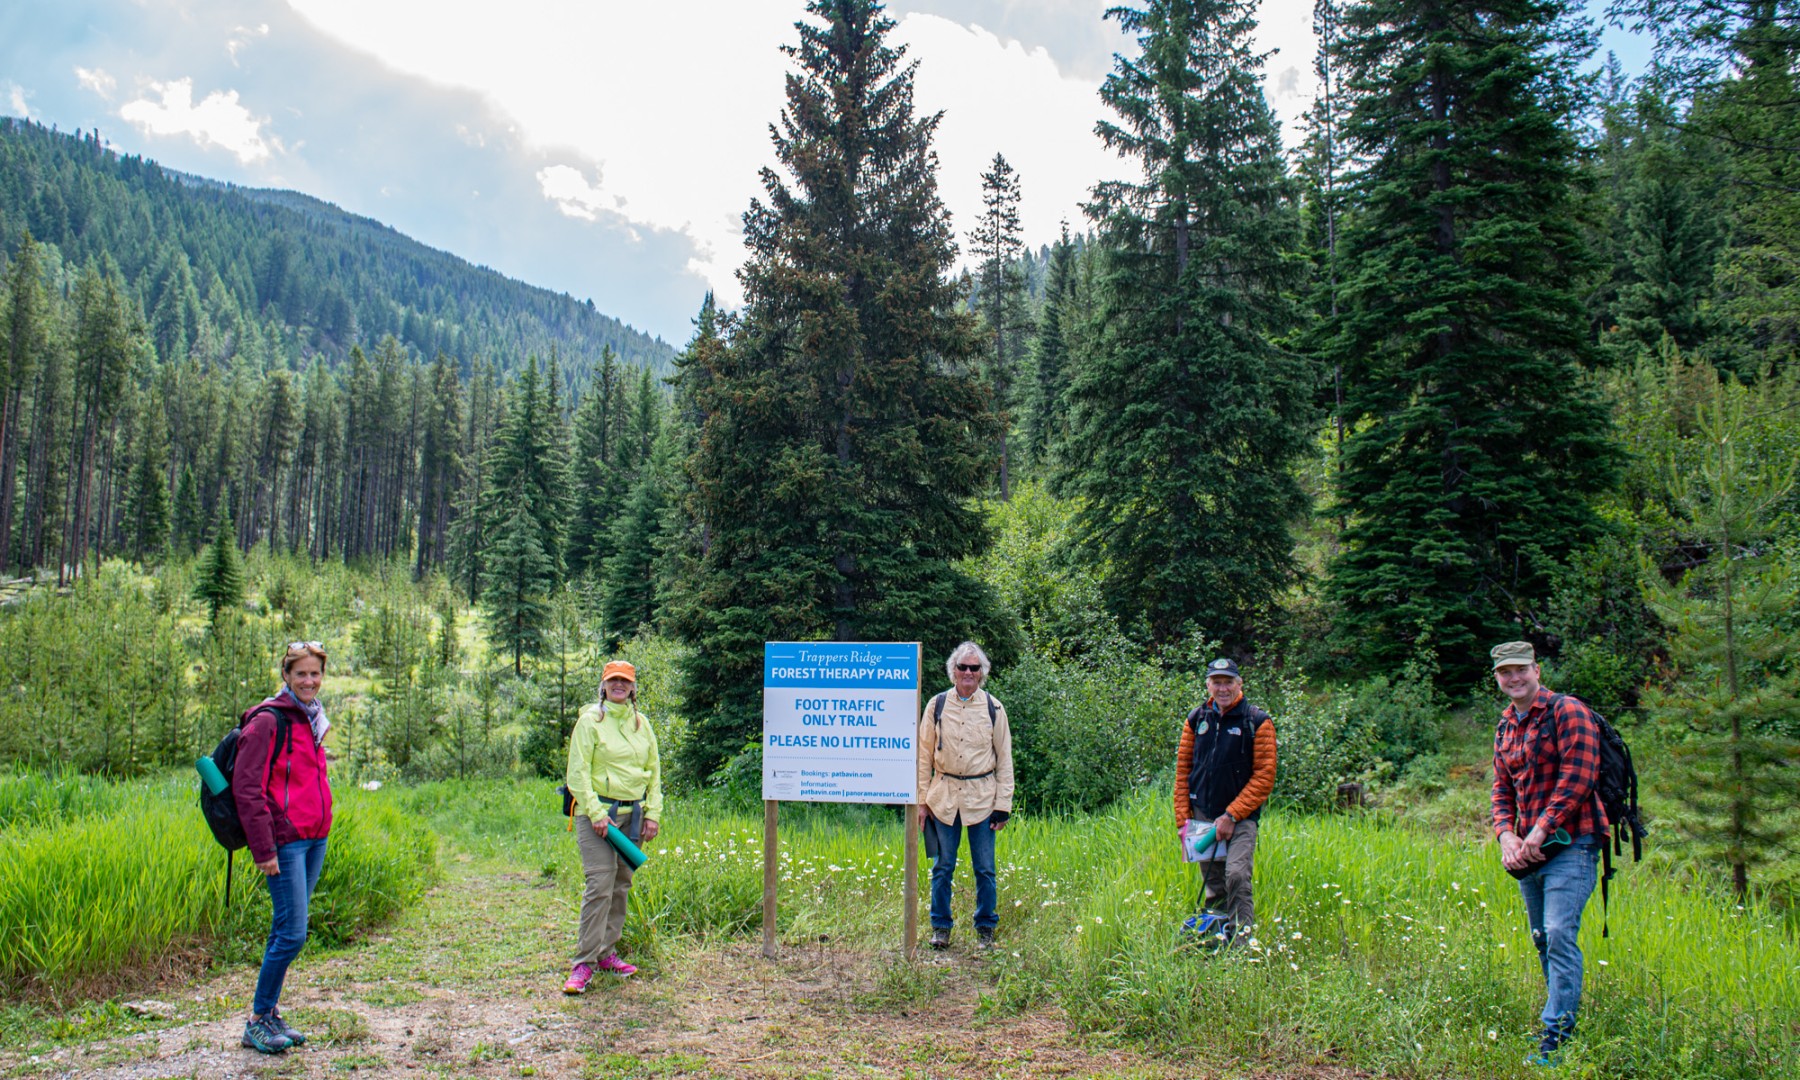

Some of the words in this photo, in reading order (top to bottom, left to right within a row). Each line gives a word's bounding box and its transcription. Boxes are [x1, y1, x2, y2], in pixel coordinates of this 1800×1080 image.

[799, 650, 848, 666] Trappers
[850, 650, 882, 666] Ridge
[771, 668, 816, 679] FOREST
[819, 668, 875, 679] THERAPY
[877, 669, 910, 680] PARK
[795, 699, 830, 710] FOOT
[831, 699, 885, 711] TRAFFIC
[803, 714, 837, 726] ONLY
[839, 715, 877, 726] TRAIL
[770, 735, 817, 747] PLEASE
[820, 736, 839, 747] NO
[843, 737, 910, 749] LITTERING
[831, 771, 872, 779] patbavin.com
